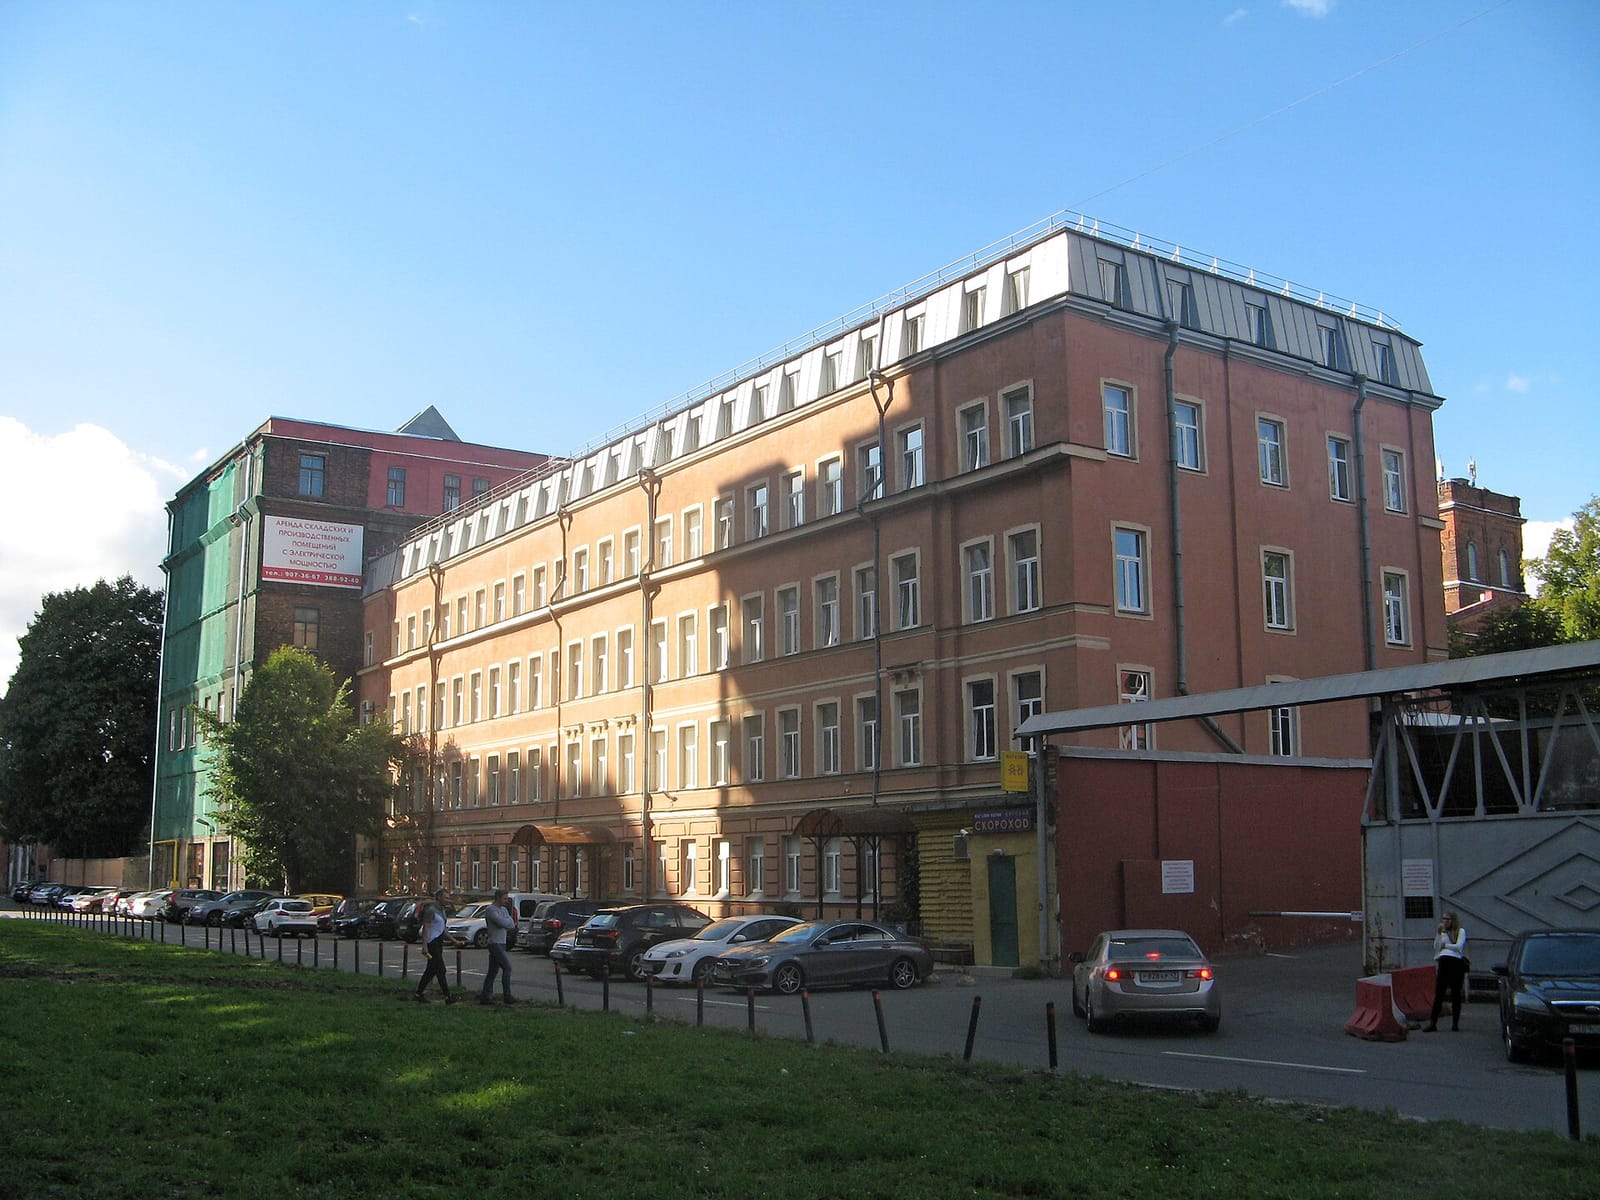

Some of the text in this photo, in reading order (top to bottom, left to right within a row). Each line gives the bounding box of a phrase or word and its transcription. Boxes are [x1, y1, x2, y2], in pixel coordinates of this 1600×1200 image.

[276, 520, 303, 529] АРЕНДА
[304, 523, 348, 533] СКЛАДСКИХ
[279, 530, 350, 542] ПРОИЗВОДСТВЕННЫХ
[292, 541, 336, 550] ПОМЕЩЕНИЙ
[290, 549, 345, 560] ЭЛЕКТРИЧЕСКОЙ
[289, 560, 337, 569] МОЩНОСТЬЮ
